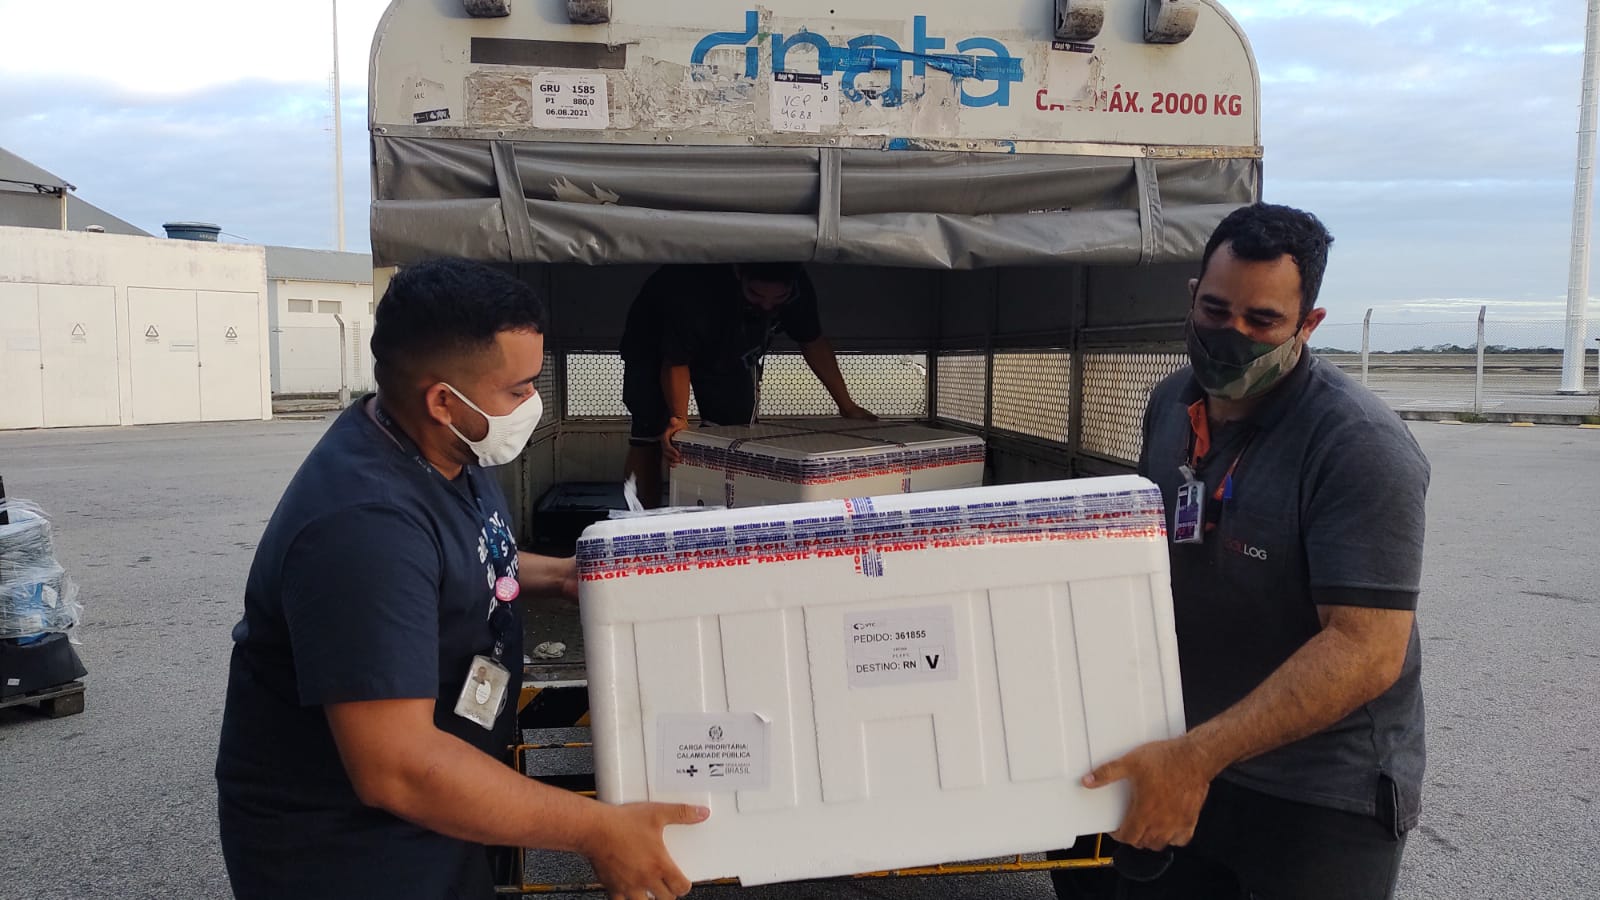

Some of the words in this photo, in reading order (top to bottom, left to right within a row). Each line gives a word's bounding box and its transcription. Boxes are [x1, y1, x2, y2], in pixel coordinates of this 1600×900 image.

[540, 84, 560, 93] GRU
[572, 85, 595, 94] 1585
[1151, 92, 1207, 114] 2000
[1213, 94, 1243, 116] KG
[545, 108, 588, 116] 06.08.2021
[853, 633, 893, 643] PEDIDO:
[895, 630, 927, 640] 361855
[856, 661, 900, 673] DESTINO:
[903, 660, 917, 669] RN
[925, 654, 940, 670] V
